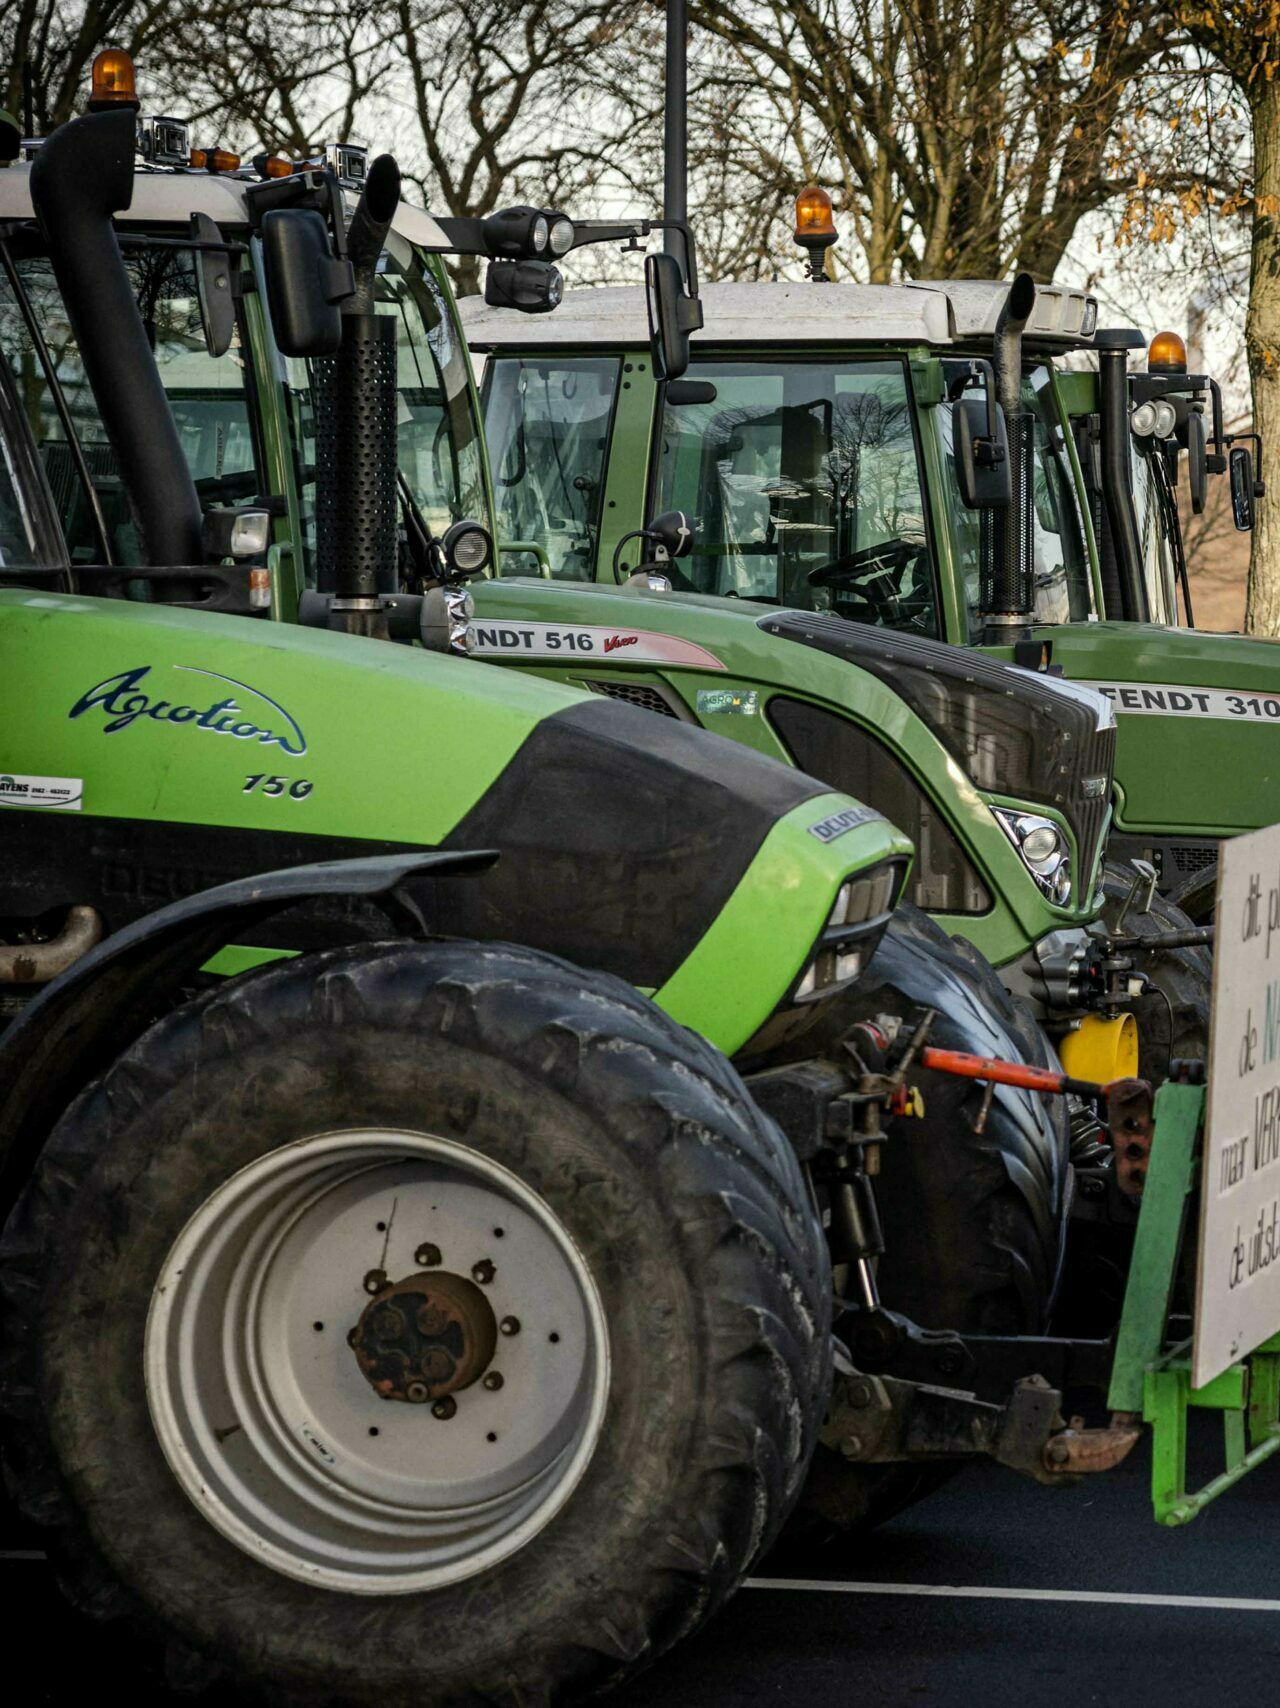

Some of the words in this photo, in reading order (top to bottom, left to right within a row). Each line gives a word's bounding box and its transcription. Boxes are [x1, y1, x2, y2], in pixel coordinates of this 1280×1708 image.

[473, 628, 535, 649] NDT
[545, 632, 594, 651] 516
[1098, 687, 1210, 713] FENDT
[242, 773, 313, 801] 150
[1242, 873, 1262, 942] dit
[1239, 1006, 1257, 1078] de
[1219, 1136, 1249, 1195] maar
[1229, 1225, 1245, 1289] de
